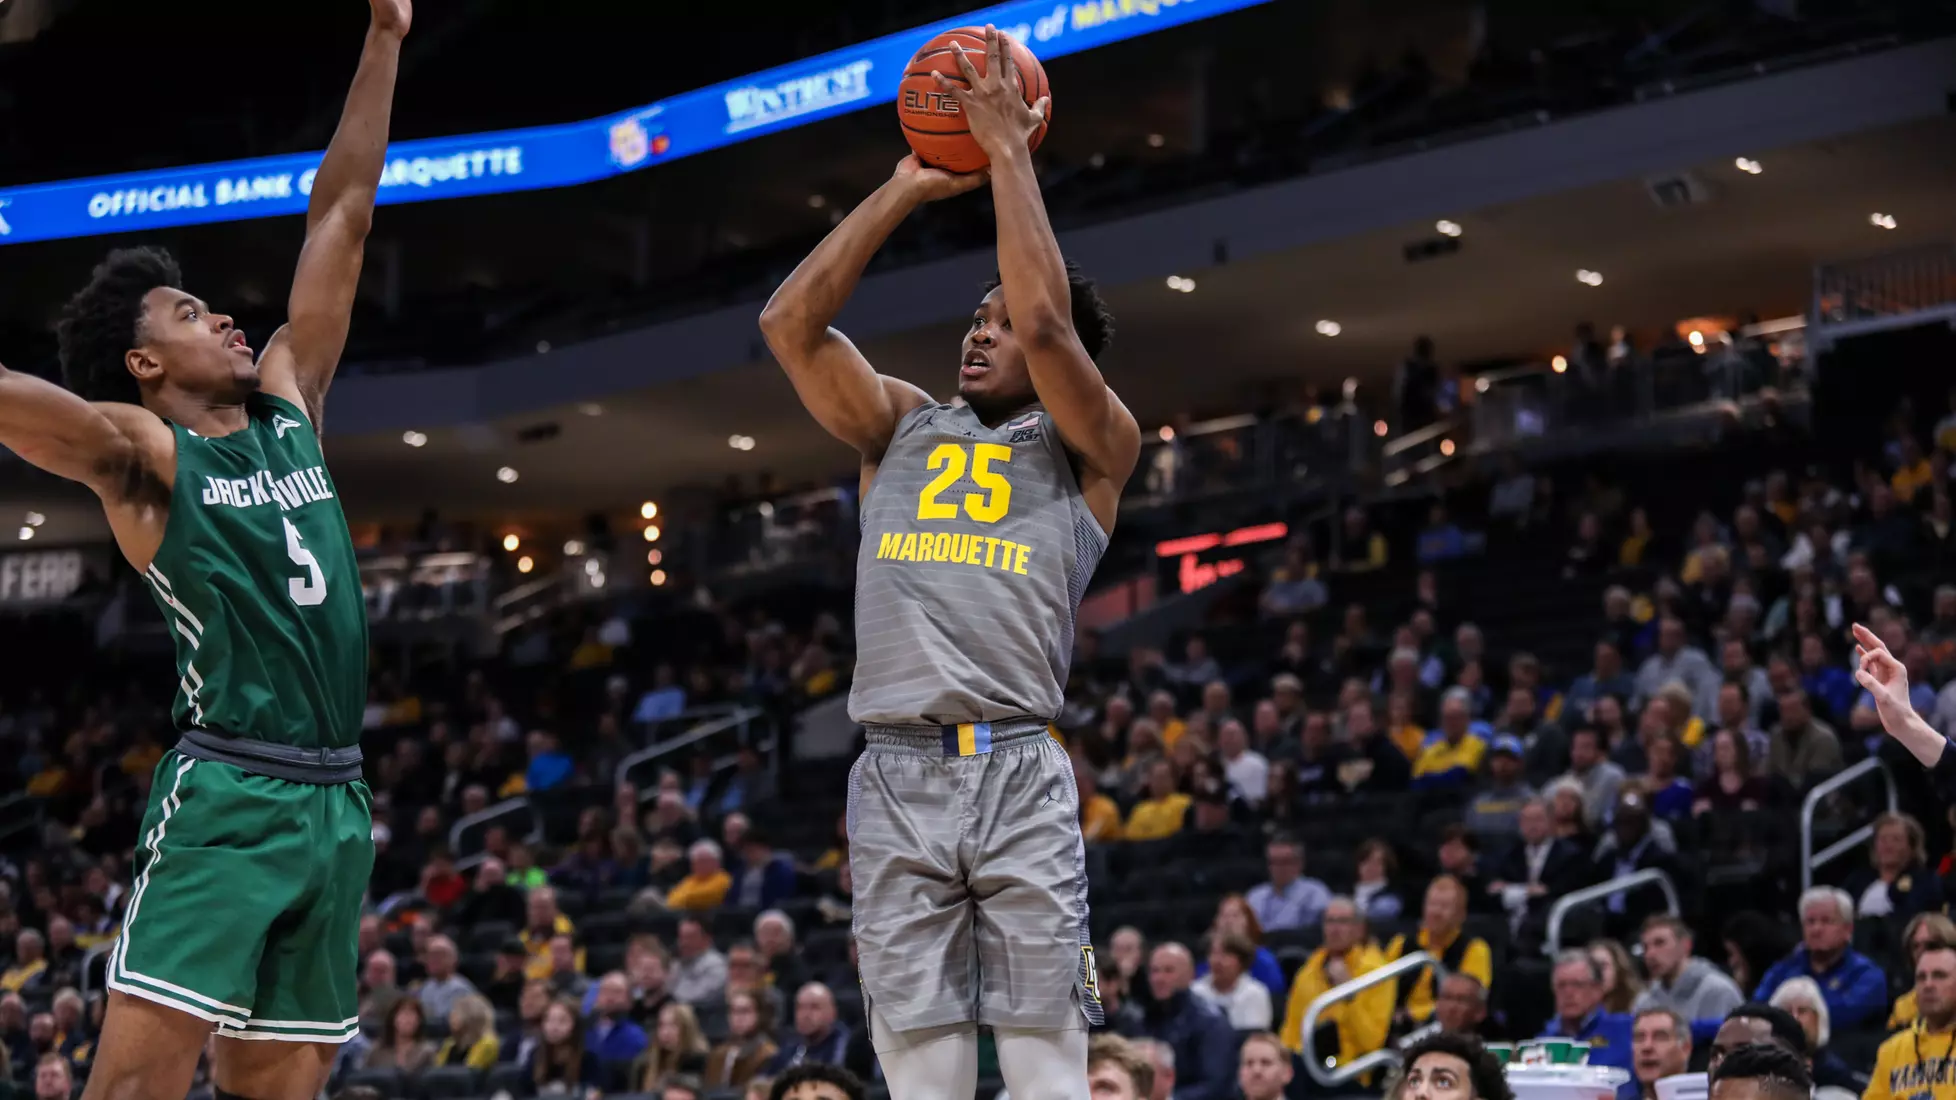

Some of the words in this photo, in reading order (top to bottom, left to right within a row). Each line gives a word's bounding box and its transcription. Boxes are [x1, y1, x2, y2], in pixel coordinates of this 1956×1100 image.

[904, 89, 960, 113] ELITE
[88, 183, 209, 218] OFFICIAL
[215, 173, 292, 206] BANK
[298, 167, 322, 196] O
[379, 146, 522, 188] ARQUETTE
[917, 443, 1012, 523] 25
[282, 517, 327, 605] 5
[876, 532, 1031, 575] MARQUETTE
